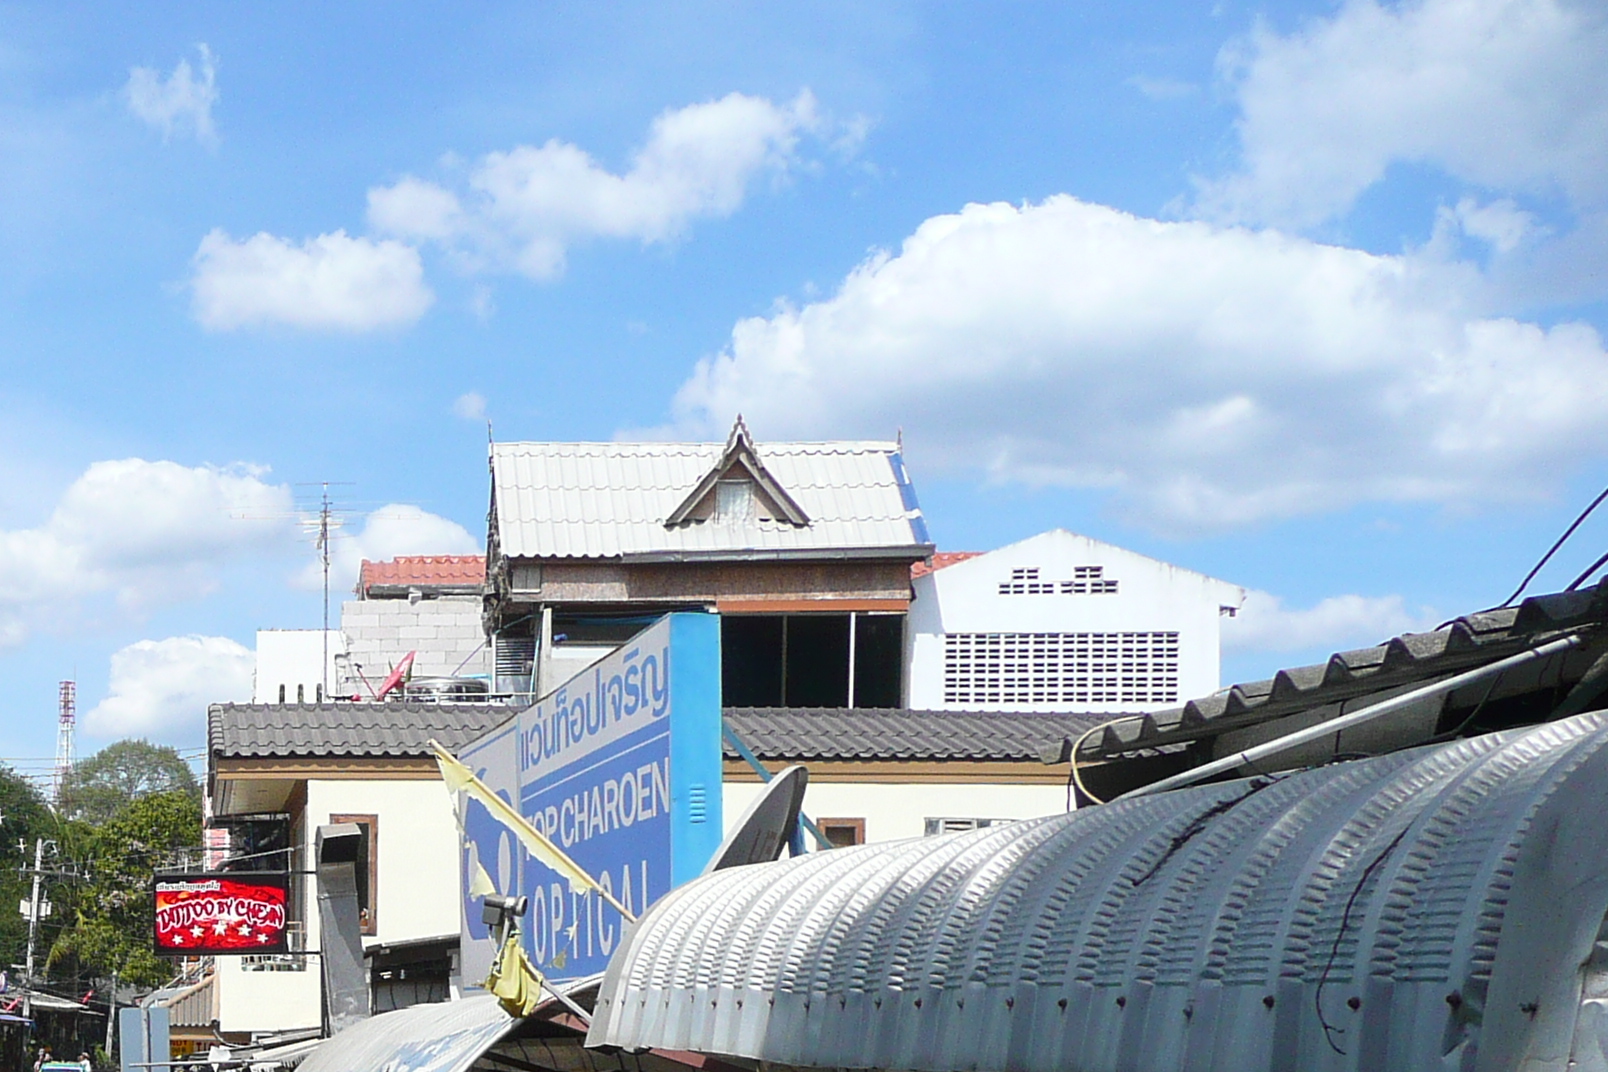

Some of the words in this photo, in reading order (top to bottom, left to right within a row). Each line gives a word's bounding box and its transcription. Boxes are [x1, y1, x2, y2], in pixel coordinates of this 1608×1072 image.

[521, 646, 670, 772] แว่นท็อปเจริญ
[560, 756, 670, 849] CHAROEN
[157, 900, 214, 931] TATTOO
[217, 899, 233, 916] BY
